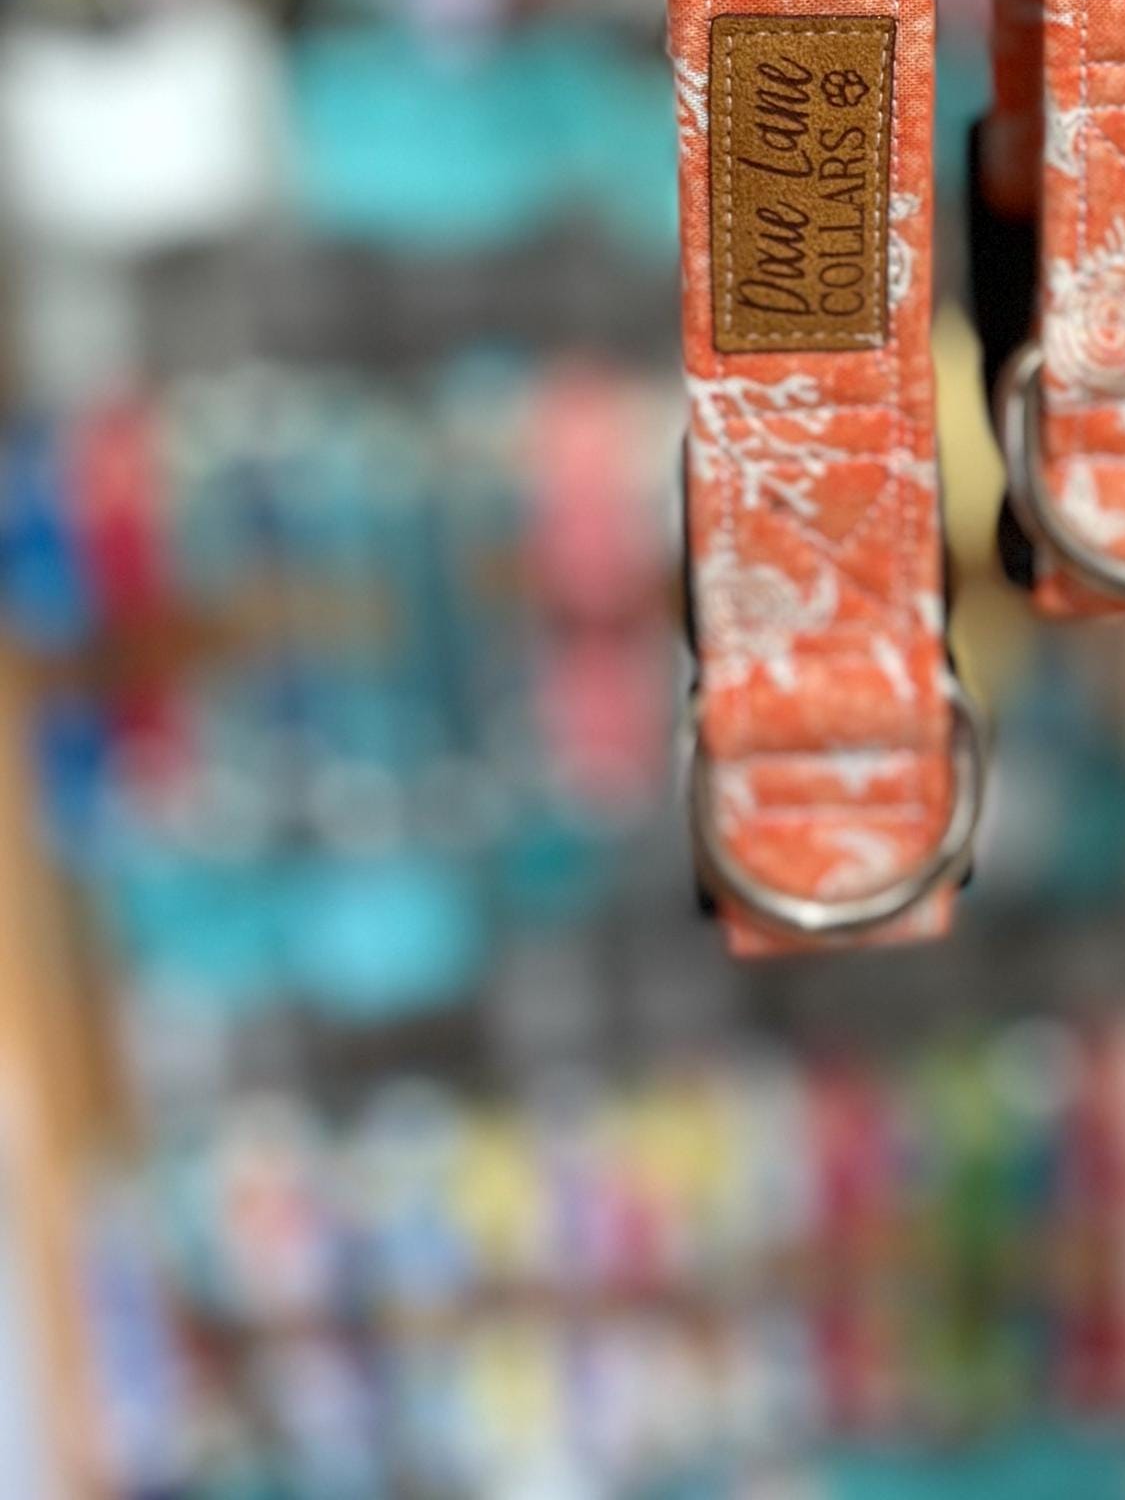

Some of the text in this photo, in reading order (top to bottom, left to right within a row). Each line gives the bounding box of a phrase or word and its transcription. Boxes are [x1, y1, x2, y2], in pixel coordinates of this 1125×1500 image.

[737, 56, 816, 316] Dixie Lane
[819, 126, 867, 317] COLLARS
